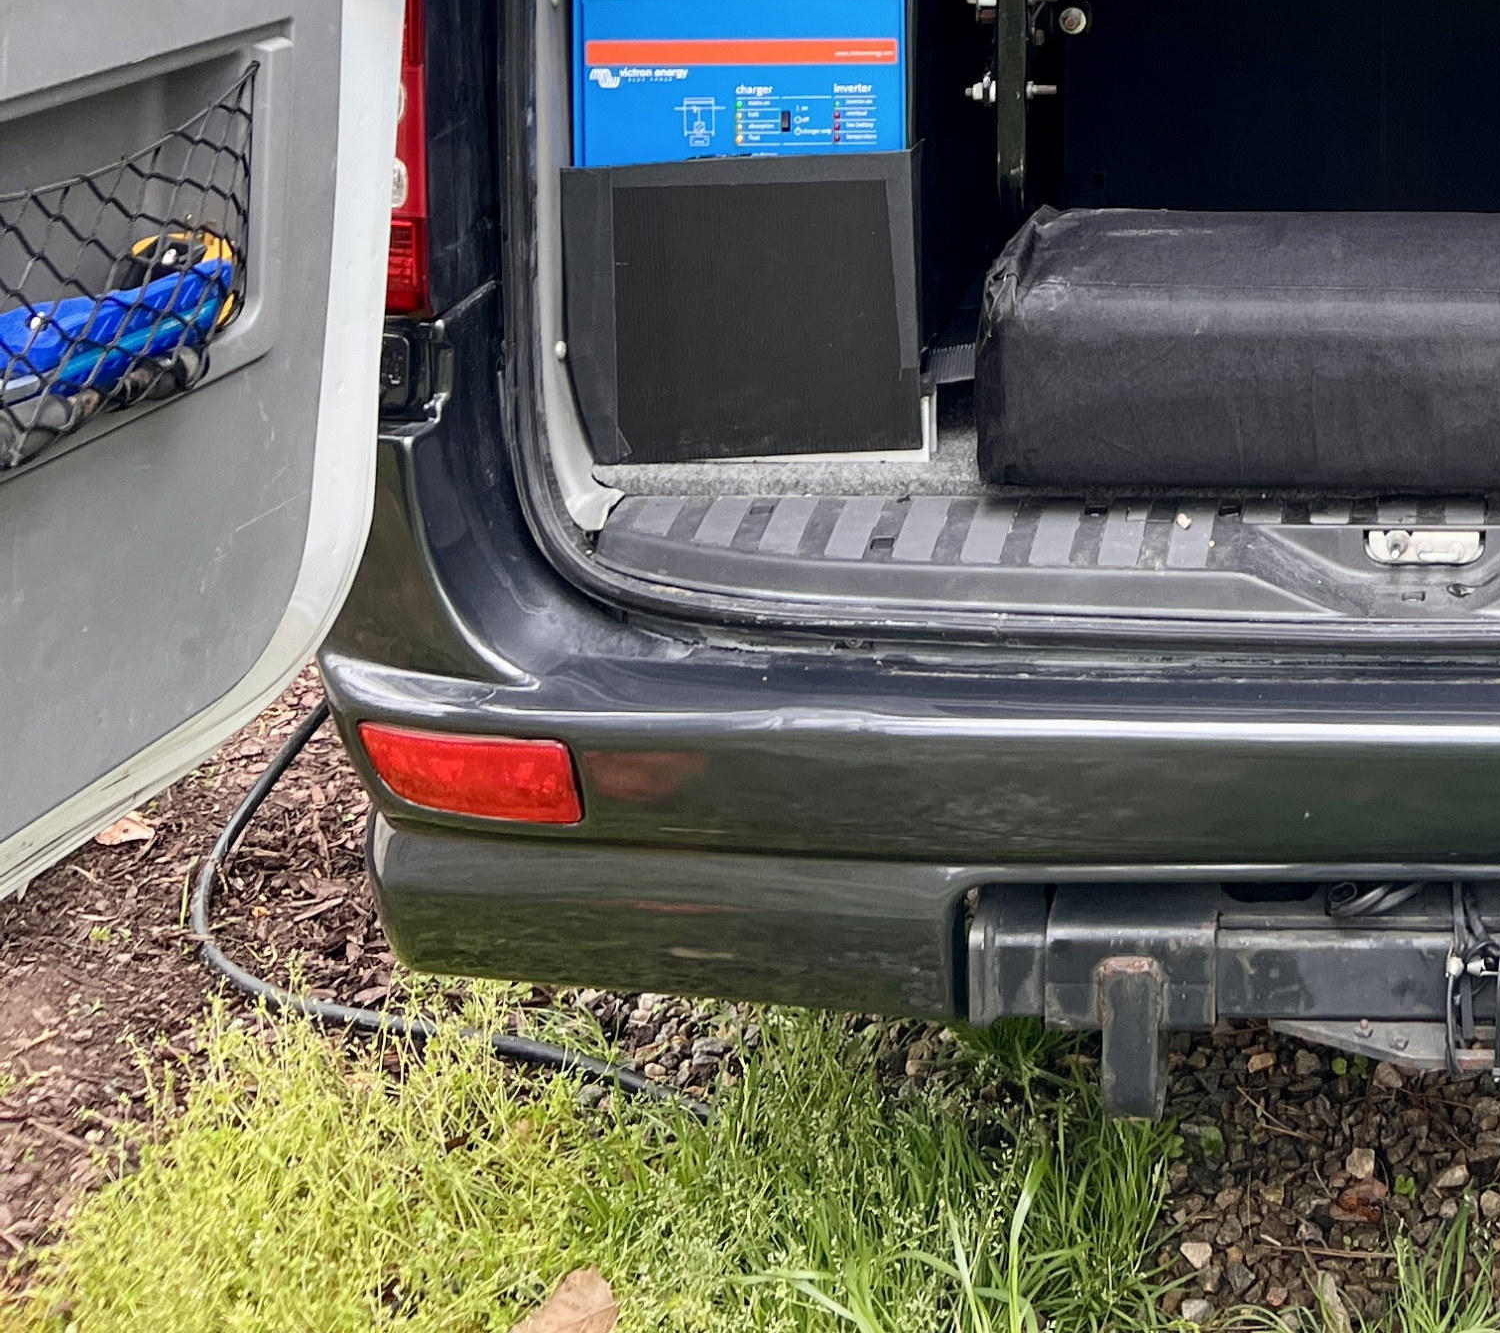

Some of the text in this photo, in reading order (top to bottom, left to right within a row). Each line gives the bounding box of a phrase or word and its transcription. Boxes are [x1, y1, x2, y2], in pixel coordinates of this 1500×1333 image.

[654, 68, 689, 79] energy
[735, 84, 773, 97] charger
[833, 83, 872, 94] inverter
